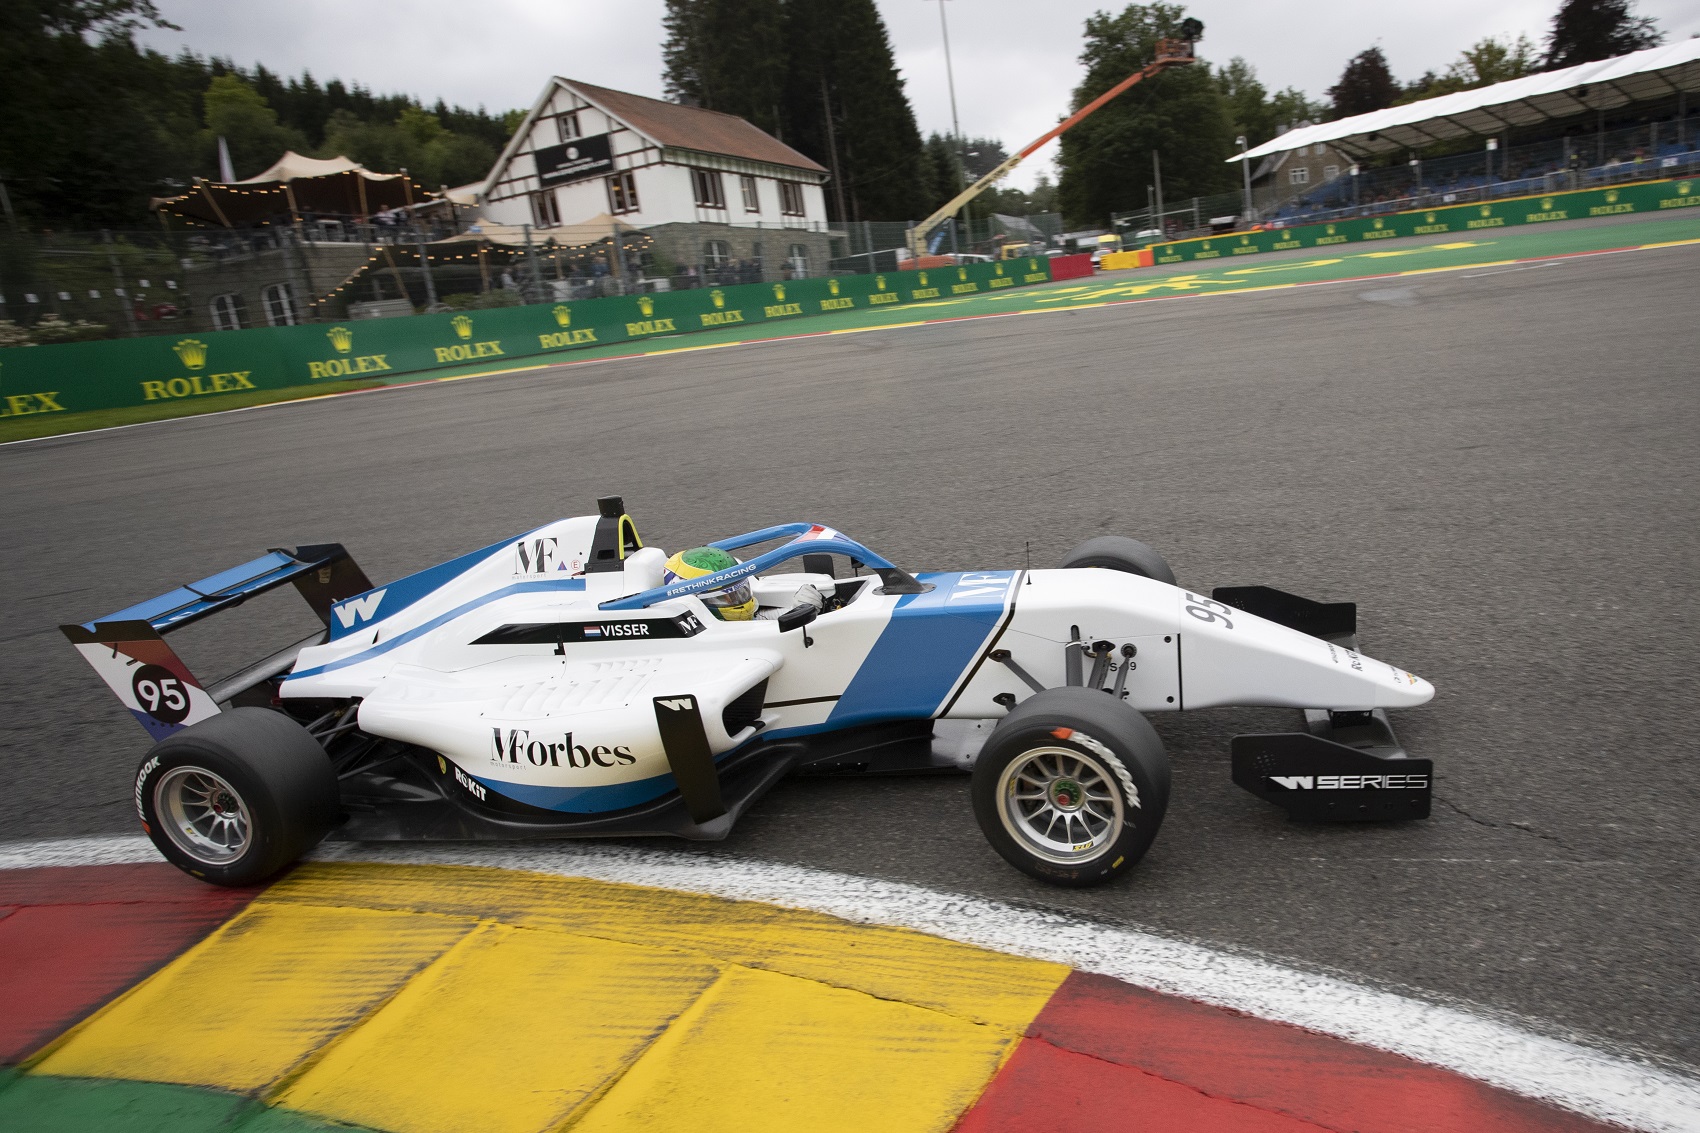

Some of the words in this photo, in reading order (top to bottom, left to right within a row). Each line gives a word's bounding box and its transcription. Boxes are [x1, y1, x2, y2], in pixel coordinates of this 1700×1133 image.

[700, 309, 744, 327] ROLEX
[763, 302, 803, 318] ROLEX
[538, 328, 598, 349] ROLEX
[626, 318, 676, 337] ROLEX
[433, 340, 505, 363] ROLEX
[307, 354, 392, 379] ROLEX
[139, 370, 257, 401] ROLEX
[666, 563, 757, 597] #RETHINKRACING
[1185, 592, 1234, 630] 95
[600, 623, 650, 637] VISSER
[137, 678, 187, 712] 95
[1315, 774, 1429, 790] SERIES
